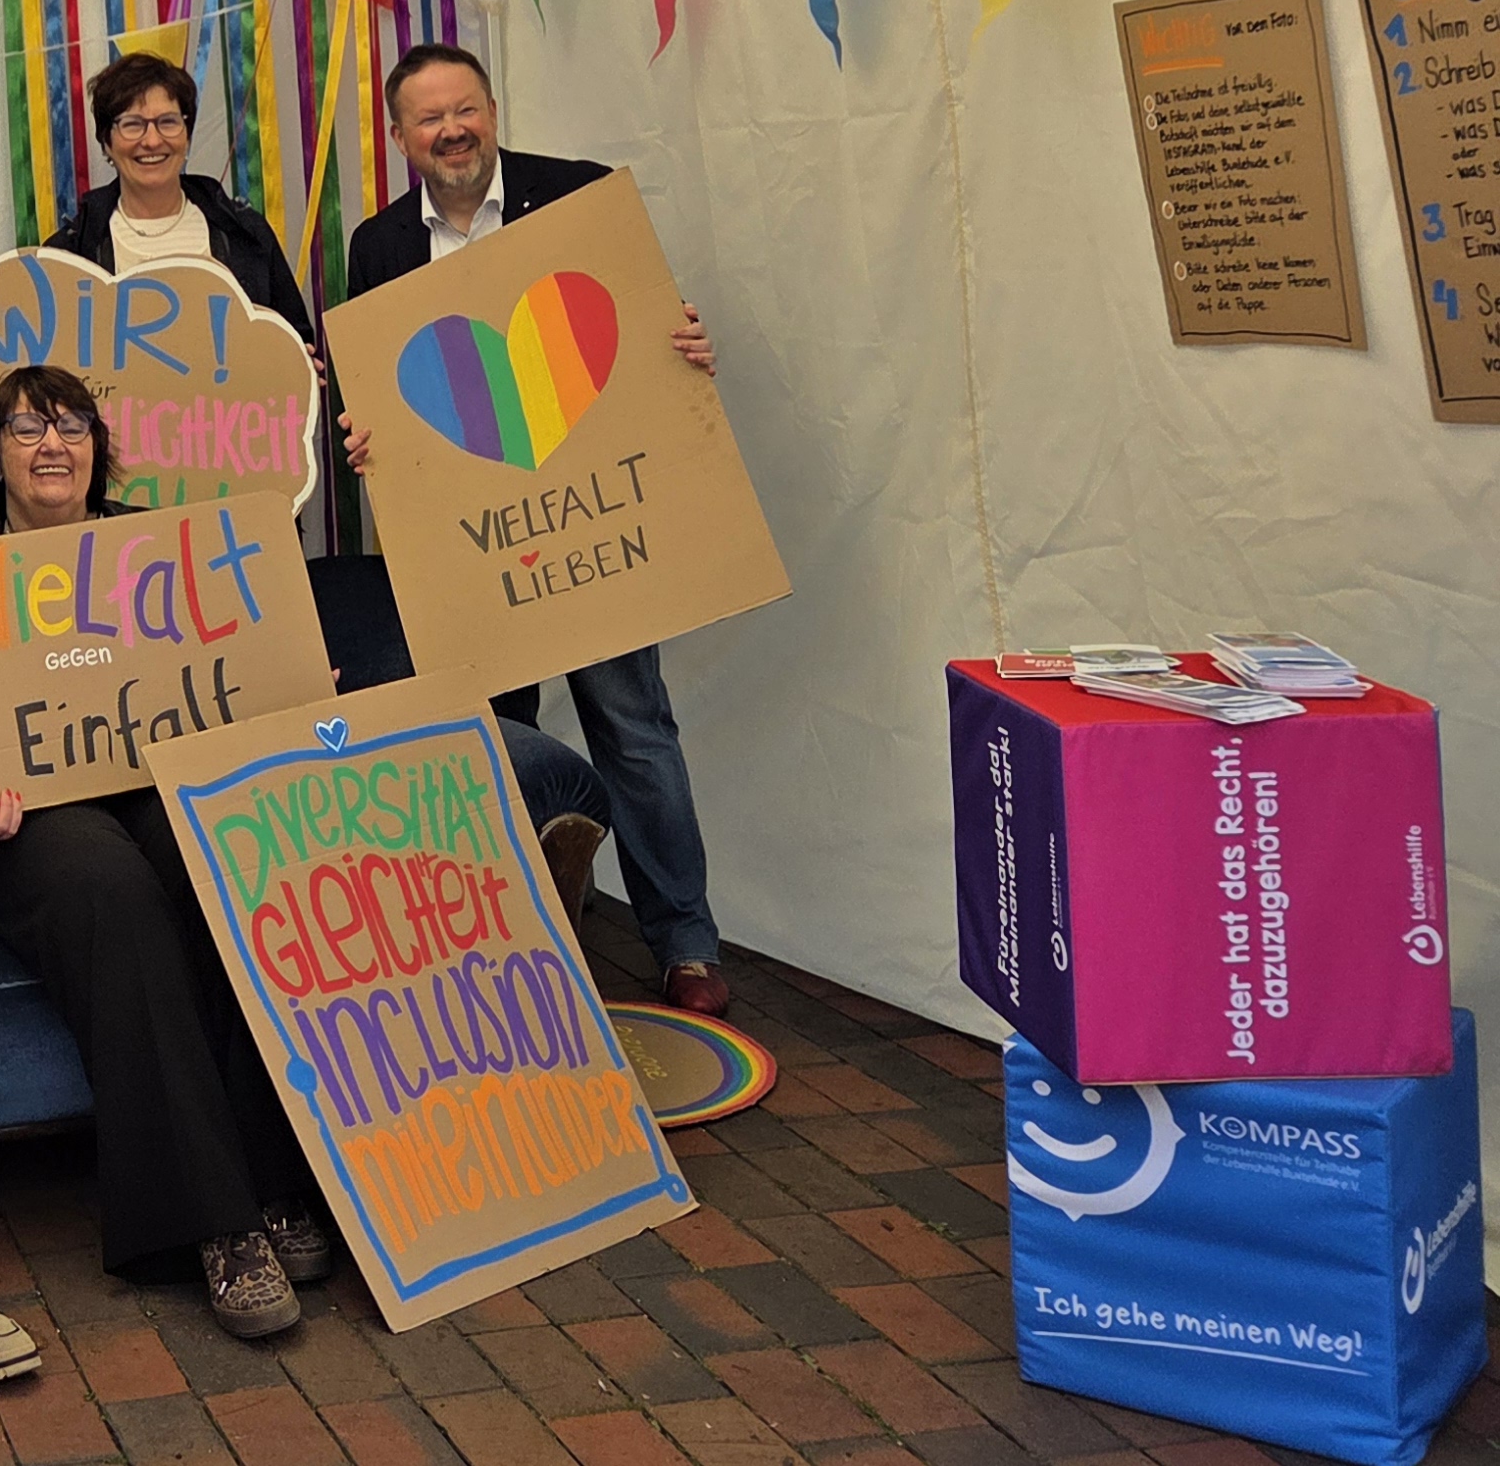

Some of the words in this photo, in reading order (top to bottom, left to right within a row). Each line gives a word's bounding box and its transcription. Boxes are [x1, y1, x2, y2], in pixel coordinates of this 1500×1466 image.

[1418, 9, 1469, 44] Nimm
[1425, 49, 1496, 89] Schreib
[1453, 201, 1496, 234] Trag
[459, 452, 647, 554] VIELFALT
[14, 657, 241, 777] Einfalt
[1210, 736, 1245, 836] Recht,
[993, 796, 1010, 976] Füreinander
[1003, 825, 1021, 1008] Miteinander
[1216, 845, 1247, 900] das
[1247, 771, 1290, 1019] dazuzugehören!
[1404, 825, 1427, 921] Lebenshilfe
[1217, 911, 1251, 964] hat
[1224, 974, 1256, 1065] Jeder
[1199, 1111, 1362, 1159] KOMPASS
[1033, 1286, 1088, 1318] Ich
[1096, 1302, 1167, 1330] gehe
[1174, 1314, 1282, 1347] meinen
[1287, 1322, 1364, 1363] Weg!
